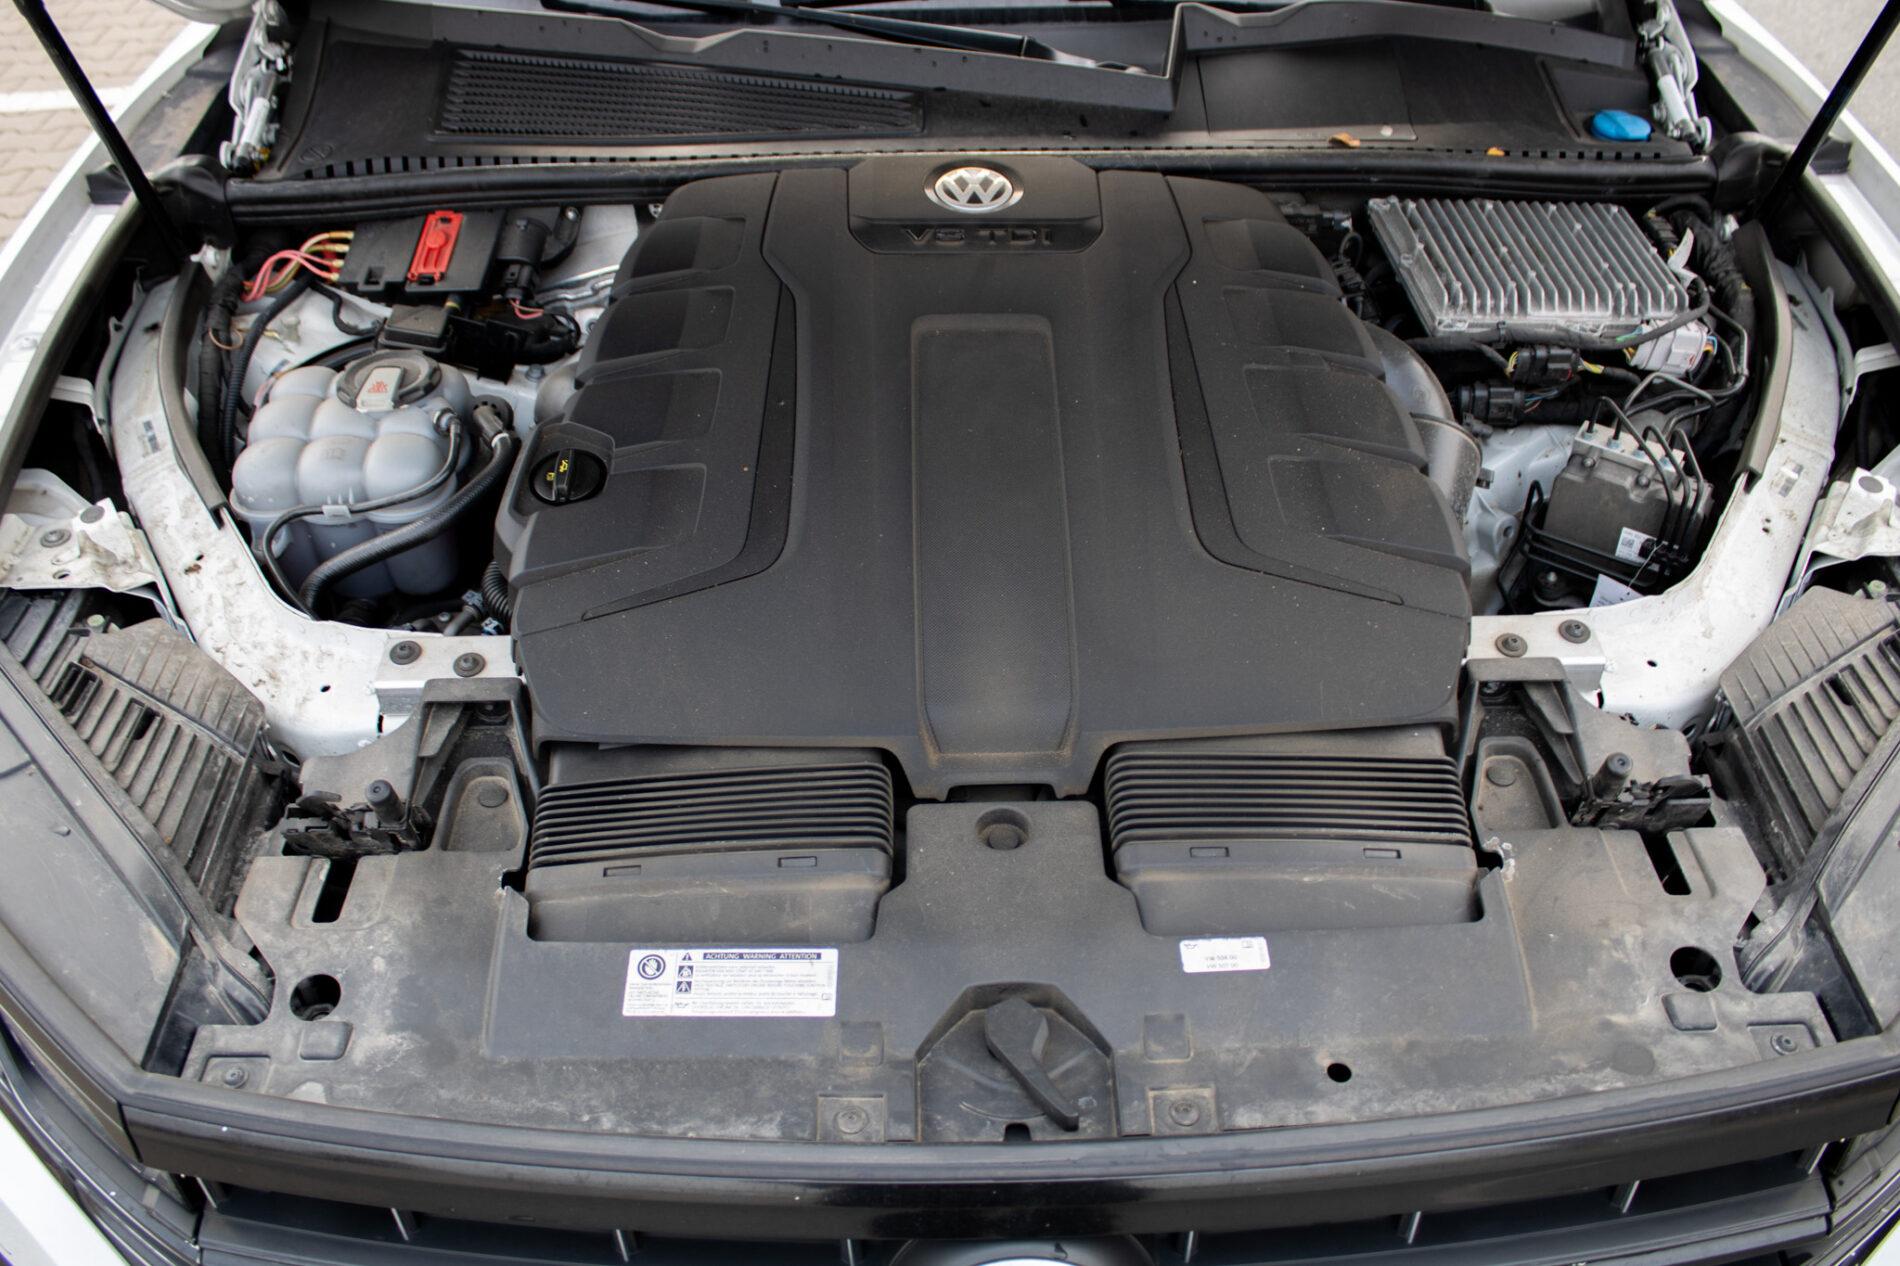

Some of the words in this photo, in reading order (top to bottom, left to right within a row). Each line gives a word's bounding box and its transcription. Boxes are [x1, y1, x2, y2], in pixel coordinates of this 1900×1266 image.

[935, 167, 1013, 212] VW
[976, 225, 1053, 246] TDI
[705, 952, 740, 960] ACHTUNG
[742, 952, 777, 960] WARNING
[779, 952, 818, 960] ATTENTION
